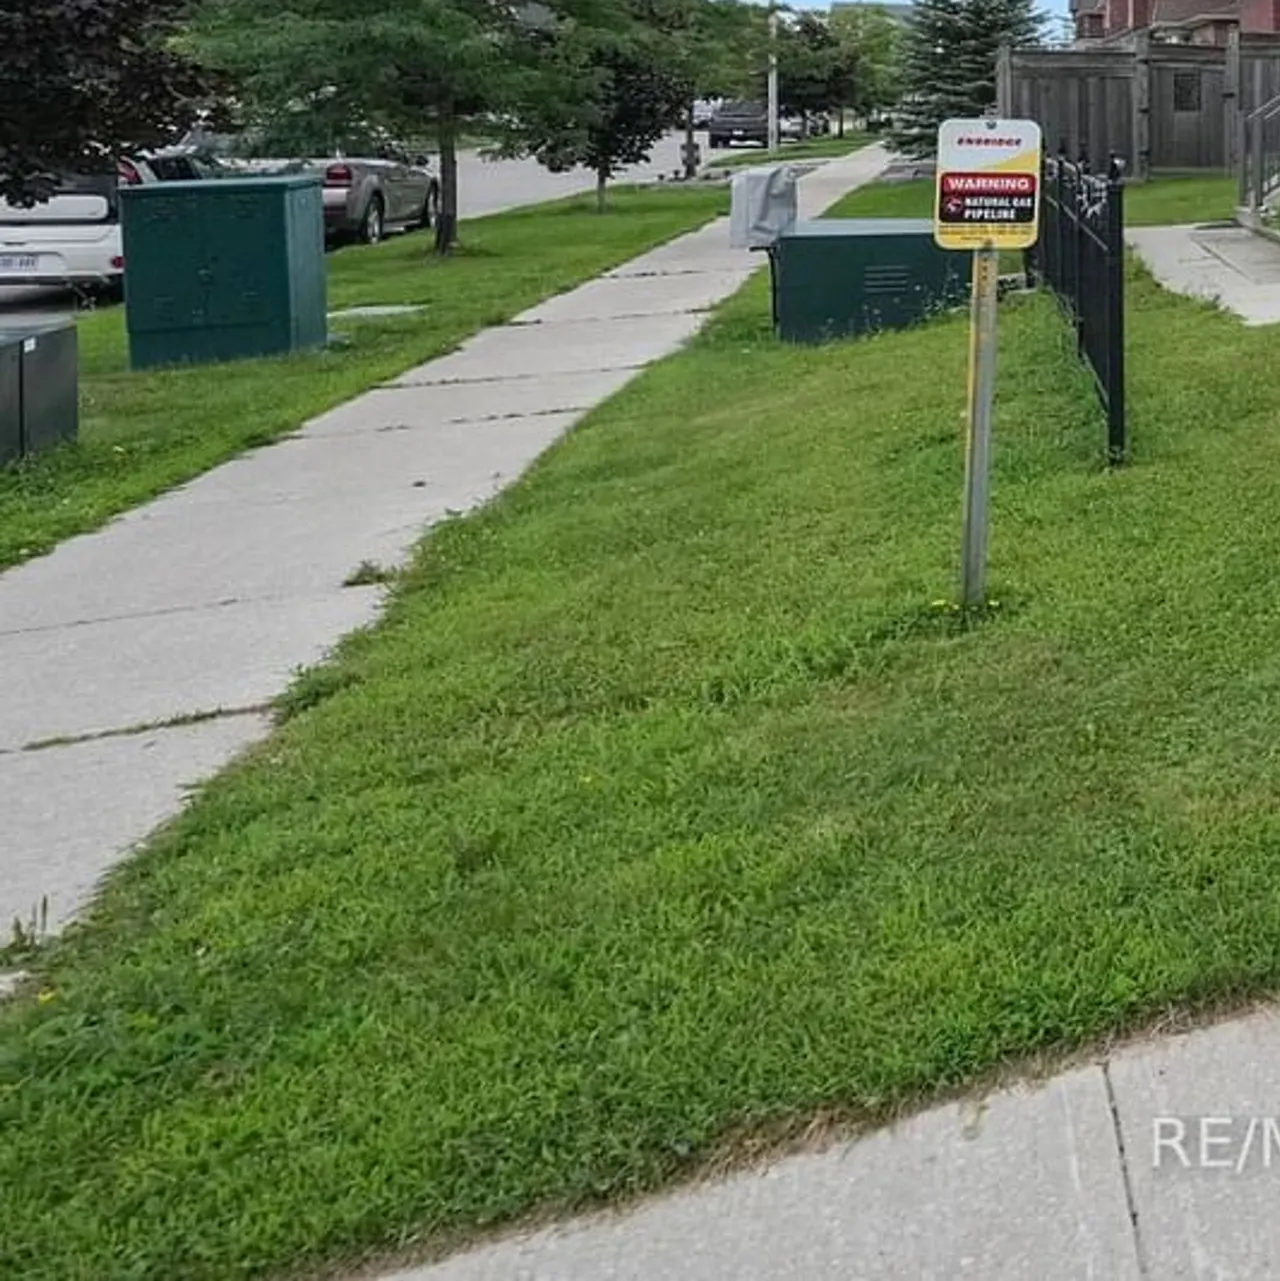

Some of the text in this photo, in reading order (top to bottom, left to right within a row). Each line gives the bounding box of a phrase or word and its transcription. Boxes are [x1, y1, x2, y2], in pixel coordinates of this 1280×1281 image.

[945, 176, 1030, 191] WARNING
[964, 197, 1033, 208] NATURAL GAS
[964, 208, 1016, 219] PIPELINE
